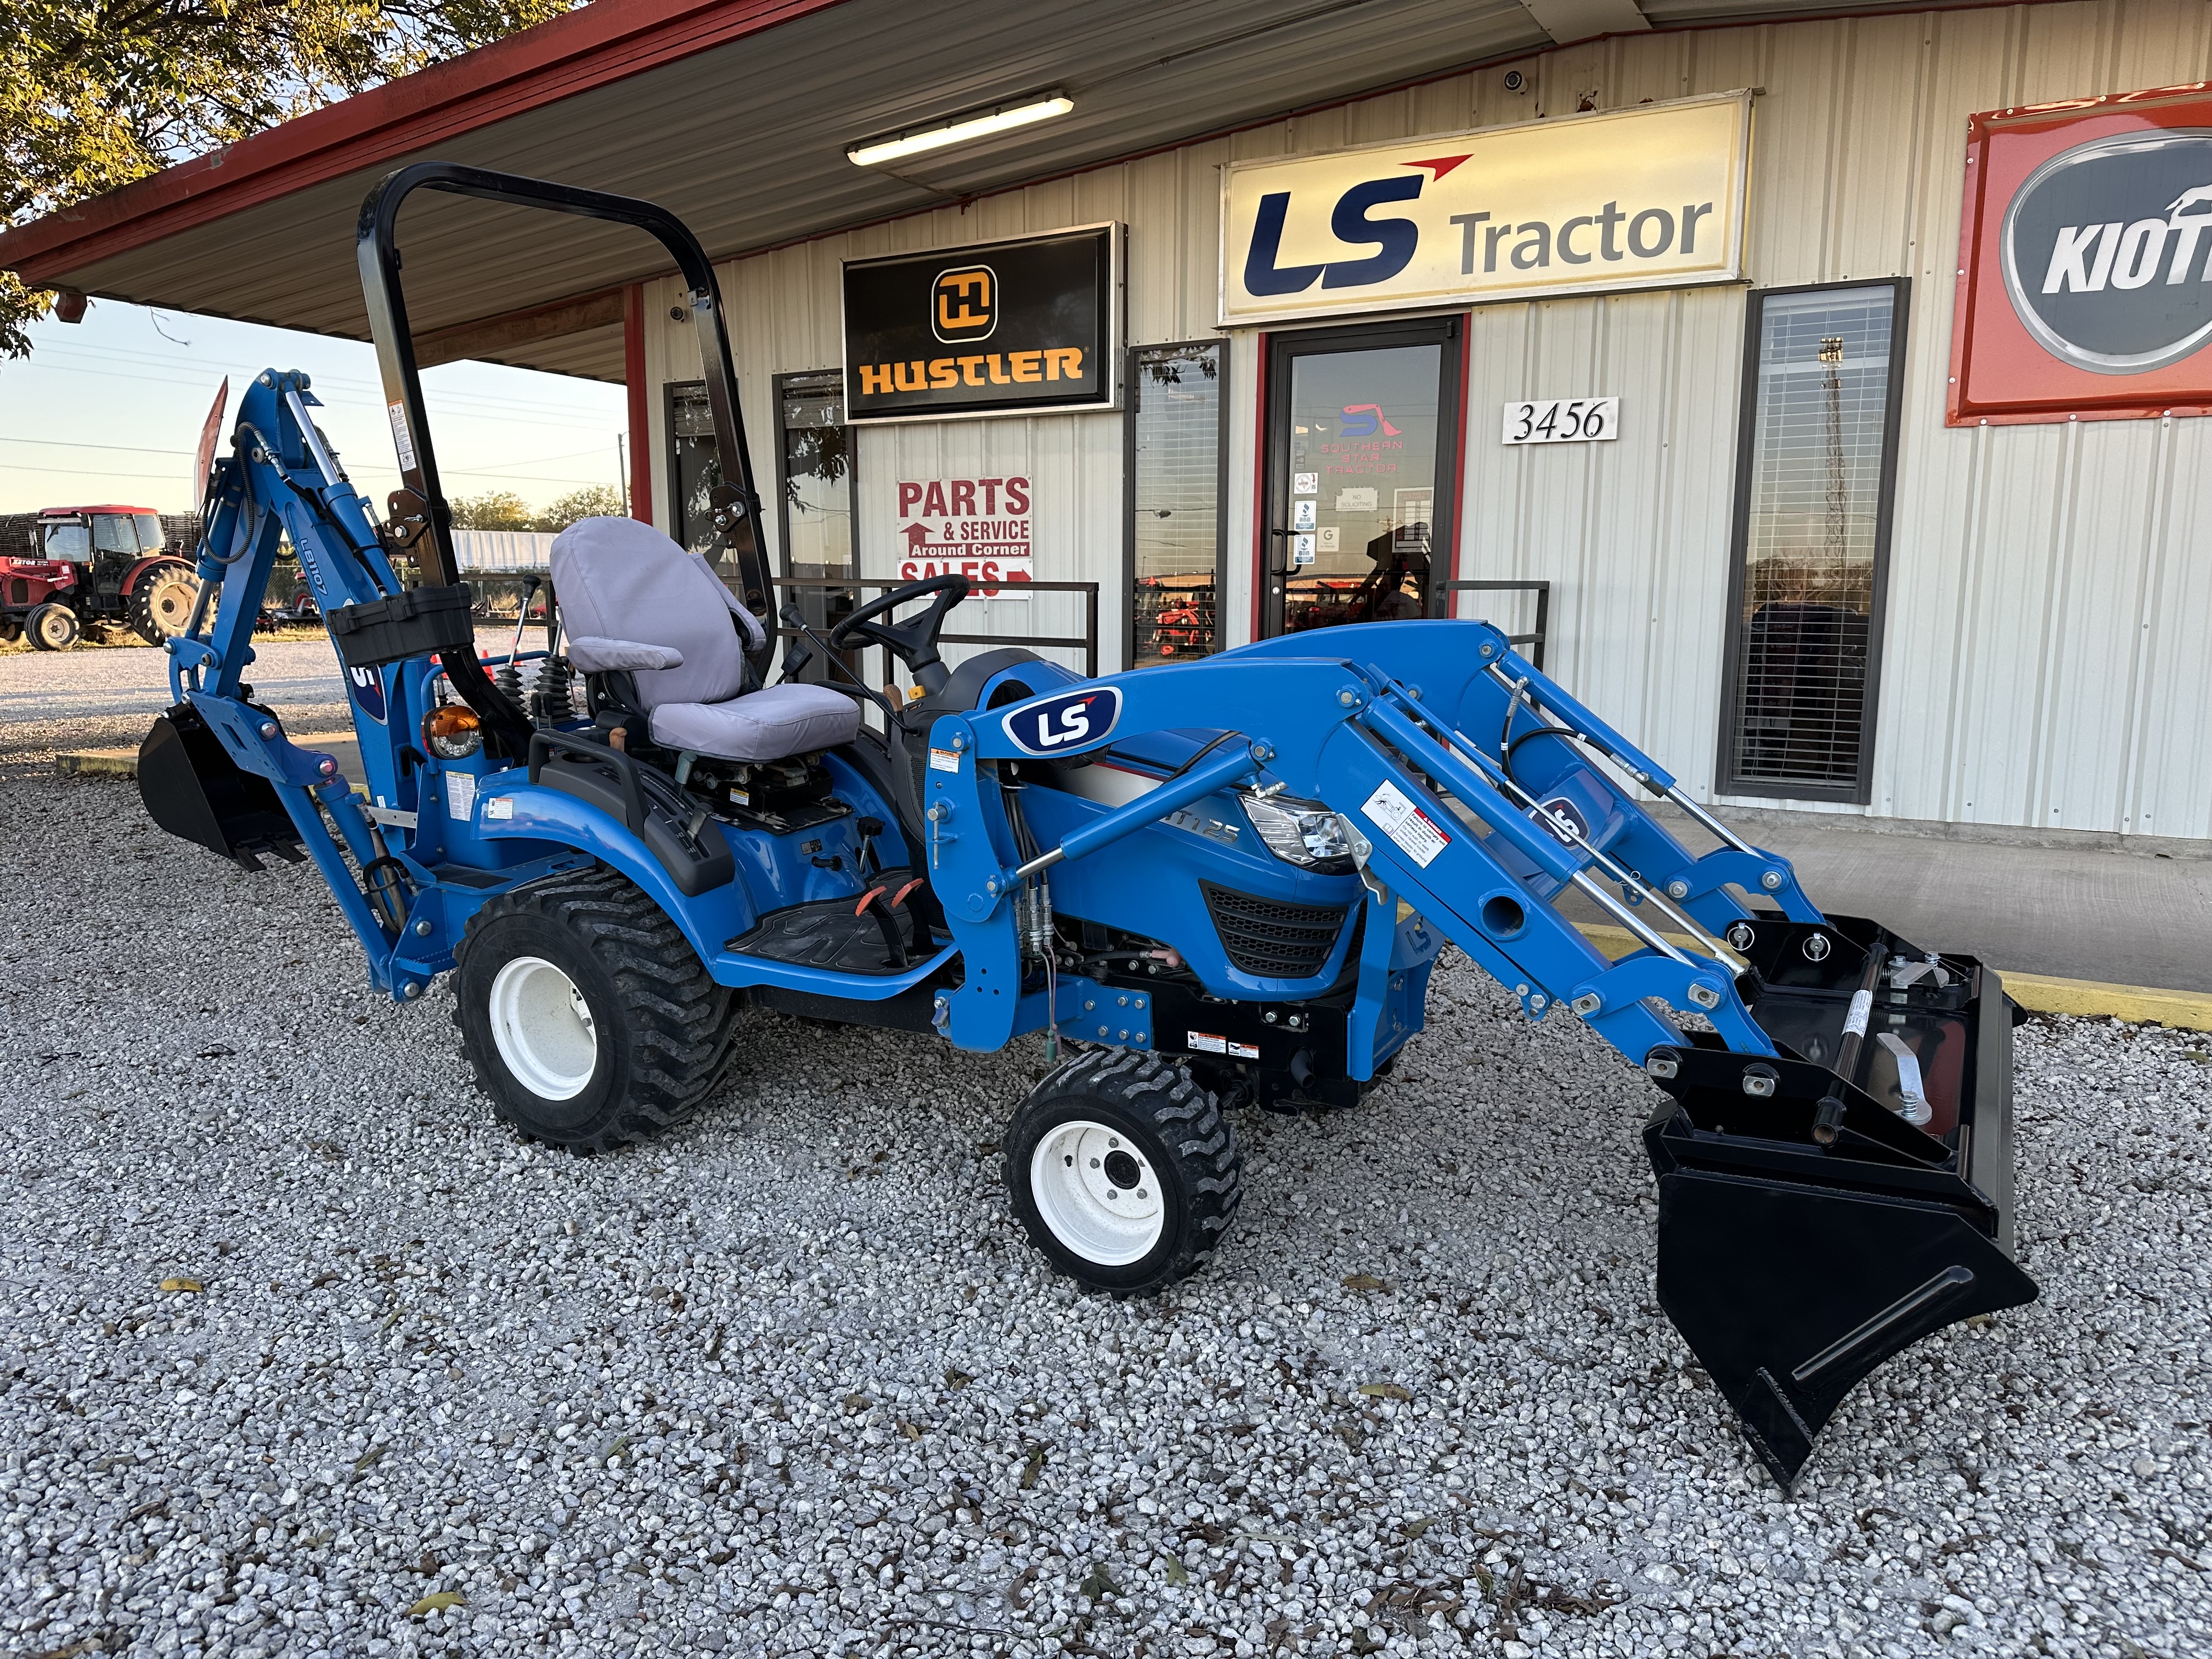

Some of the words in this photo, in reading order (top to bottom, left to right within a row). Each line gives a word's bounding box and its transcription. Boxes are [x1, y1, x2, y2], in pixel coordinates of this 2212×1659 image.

[1244, 174, 1424, 297] LS
[1449, 200, 1713, 275] Tractor
[2041, 213, 2212, 295] KIOT
[859, 347, 1082, 395] HUSTLER
[1514, 401, 1608, 441] 3456
[1321, 441, 1403, 453] SOUTHERN
[1342, 453, 1380, 463] STAR
[1325, 464, 1397, 475] TRACTOR
[899, 477, 1030, 518] PARTS
[911, 544, 967, 557] Around
[972, 543, 1027, 556] Corner
[944, 522, 955, 540] &
[961, 520, 1029, 540] SERVICE
[300, 538, 328, 595] LB1107
[1039, 703, 1090, 747] LS
[1165, 810, 1240, 843] T125
